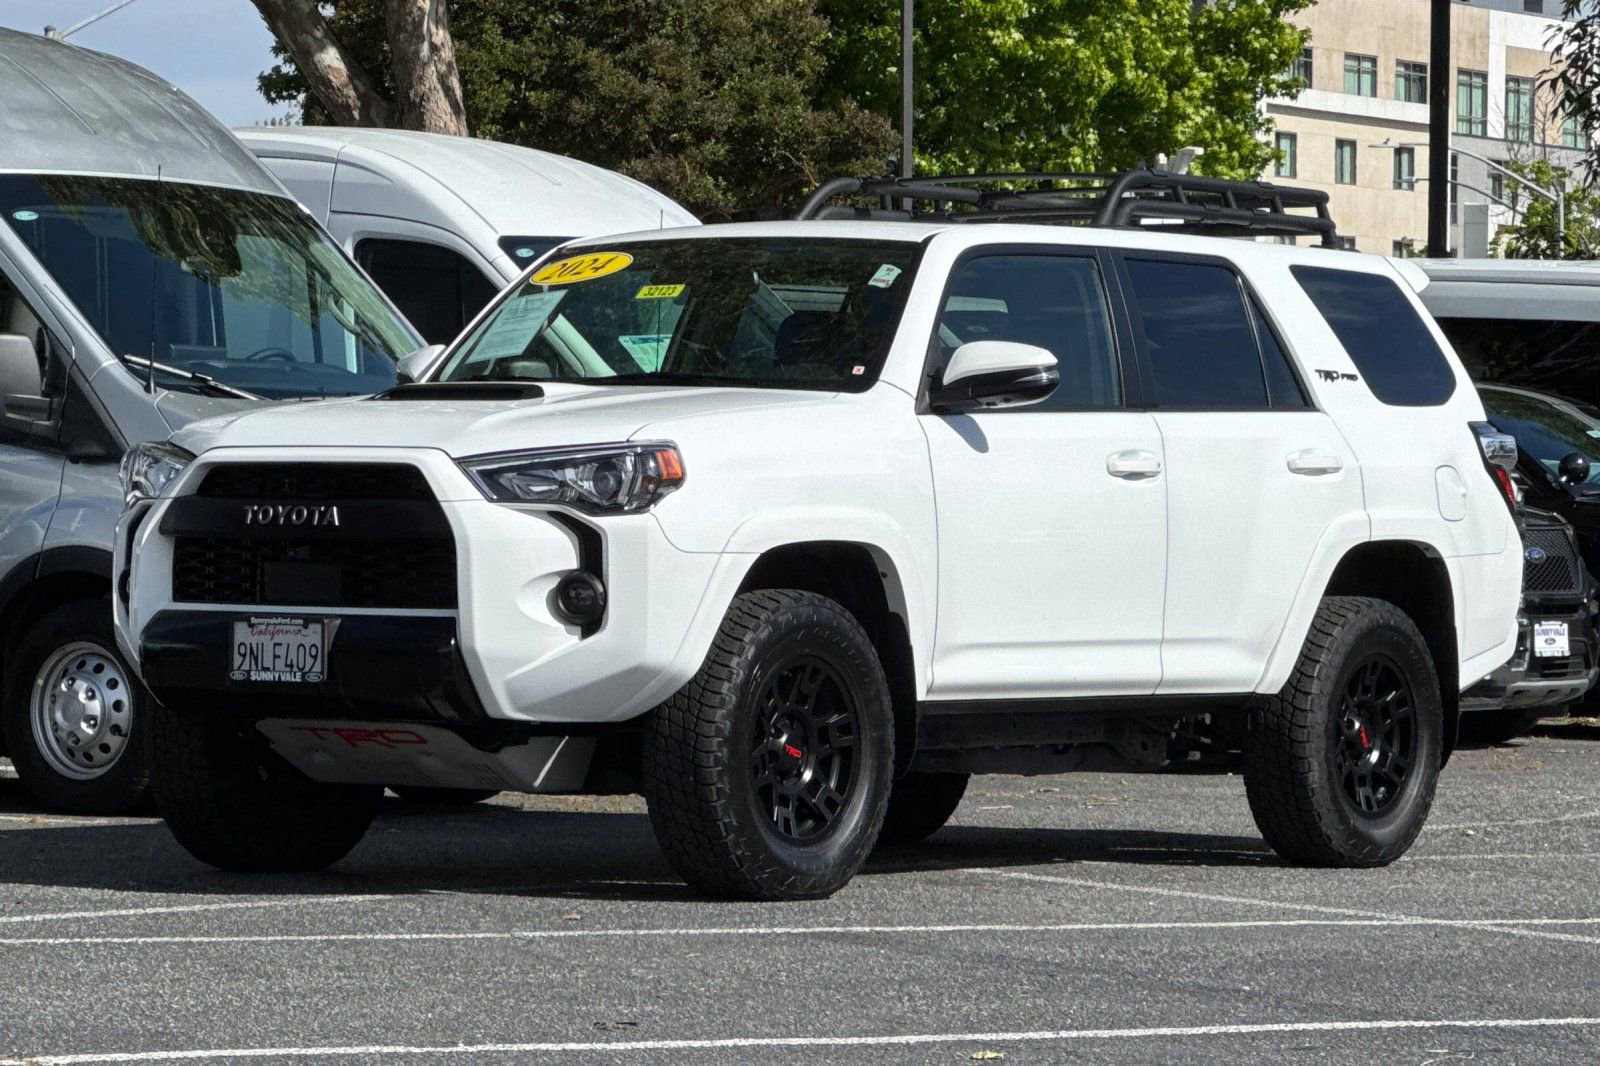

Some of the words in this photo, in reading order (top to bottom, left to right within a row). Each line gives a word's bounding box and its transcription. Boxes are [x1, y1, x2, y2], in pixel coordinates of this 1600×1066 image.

[540, 255, 620, 281] 2024
[643, 286, 678, 297] 32123
[243, 505, 340, 526] TOYOTA
[250, 624, 303, 641] California
[1535, 627, 1566, 637] SUNNYVALE
[237, 641, 319, 672] 9NLF409
[250, 670, 303, 682] SUNNYVALE
[290, 726, 428, 749] TRD
